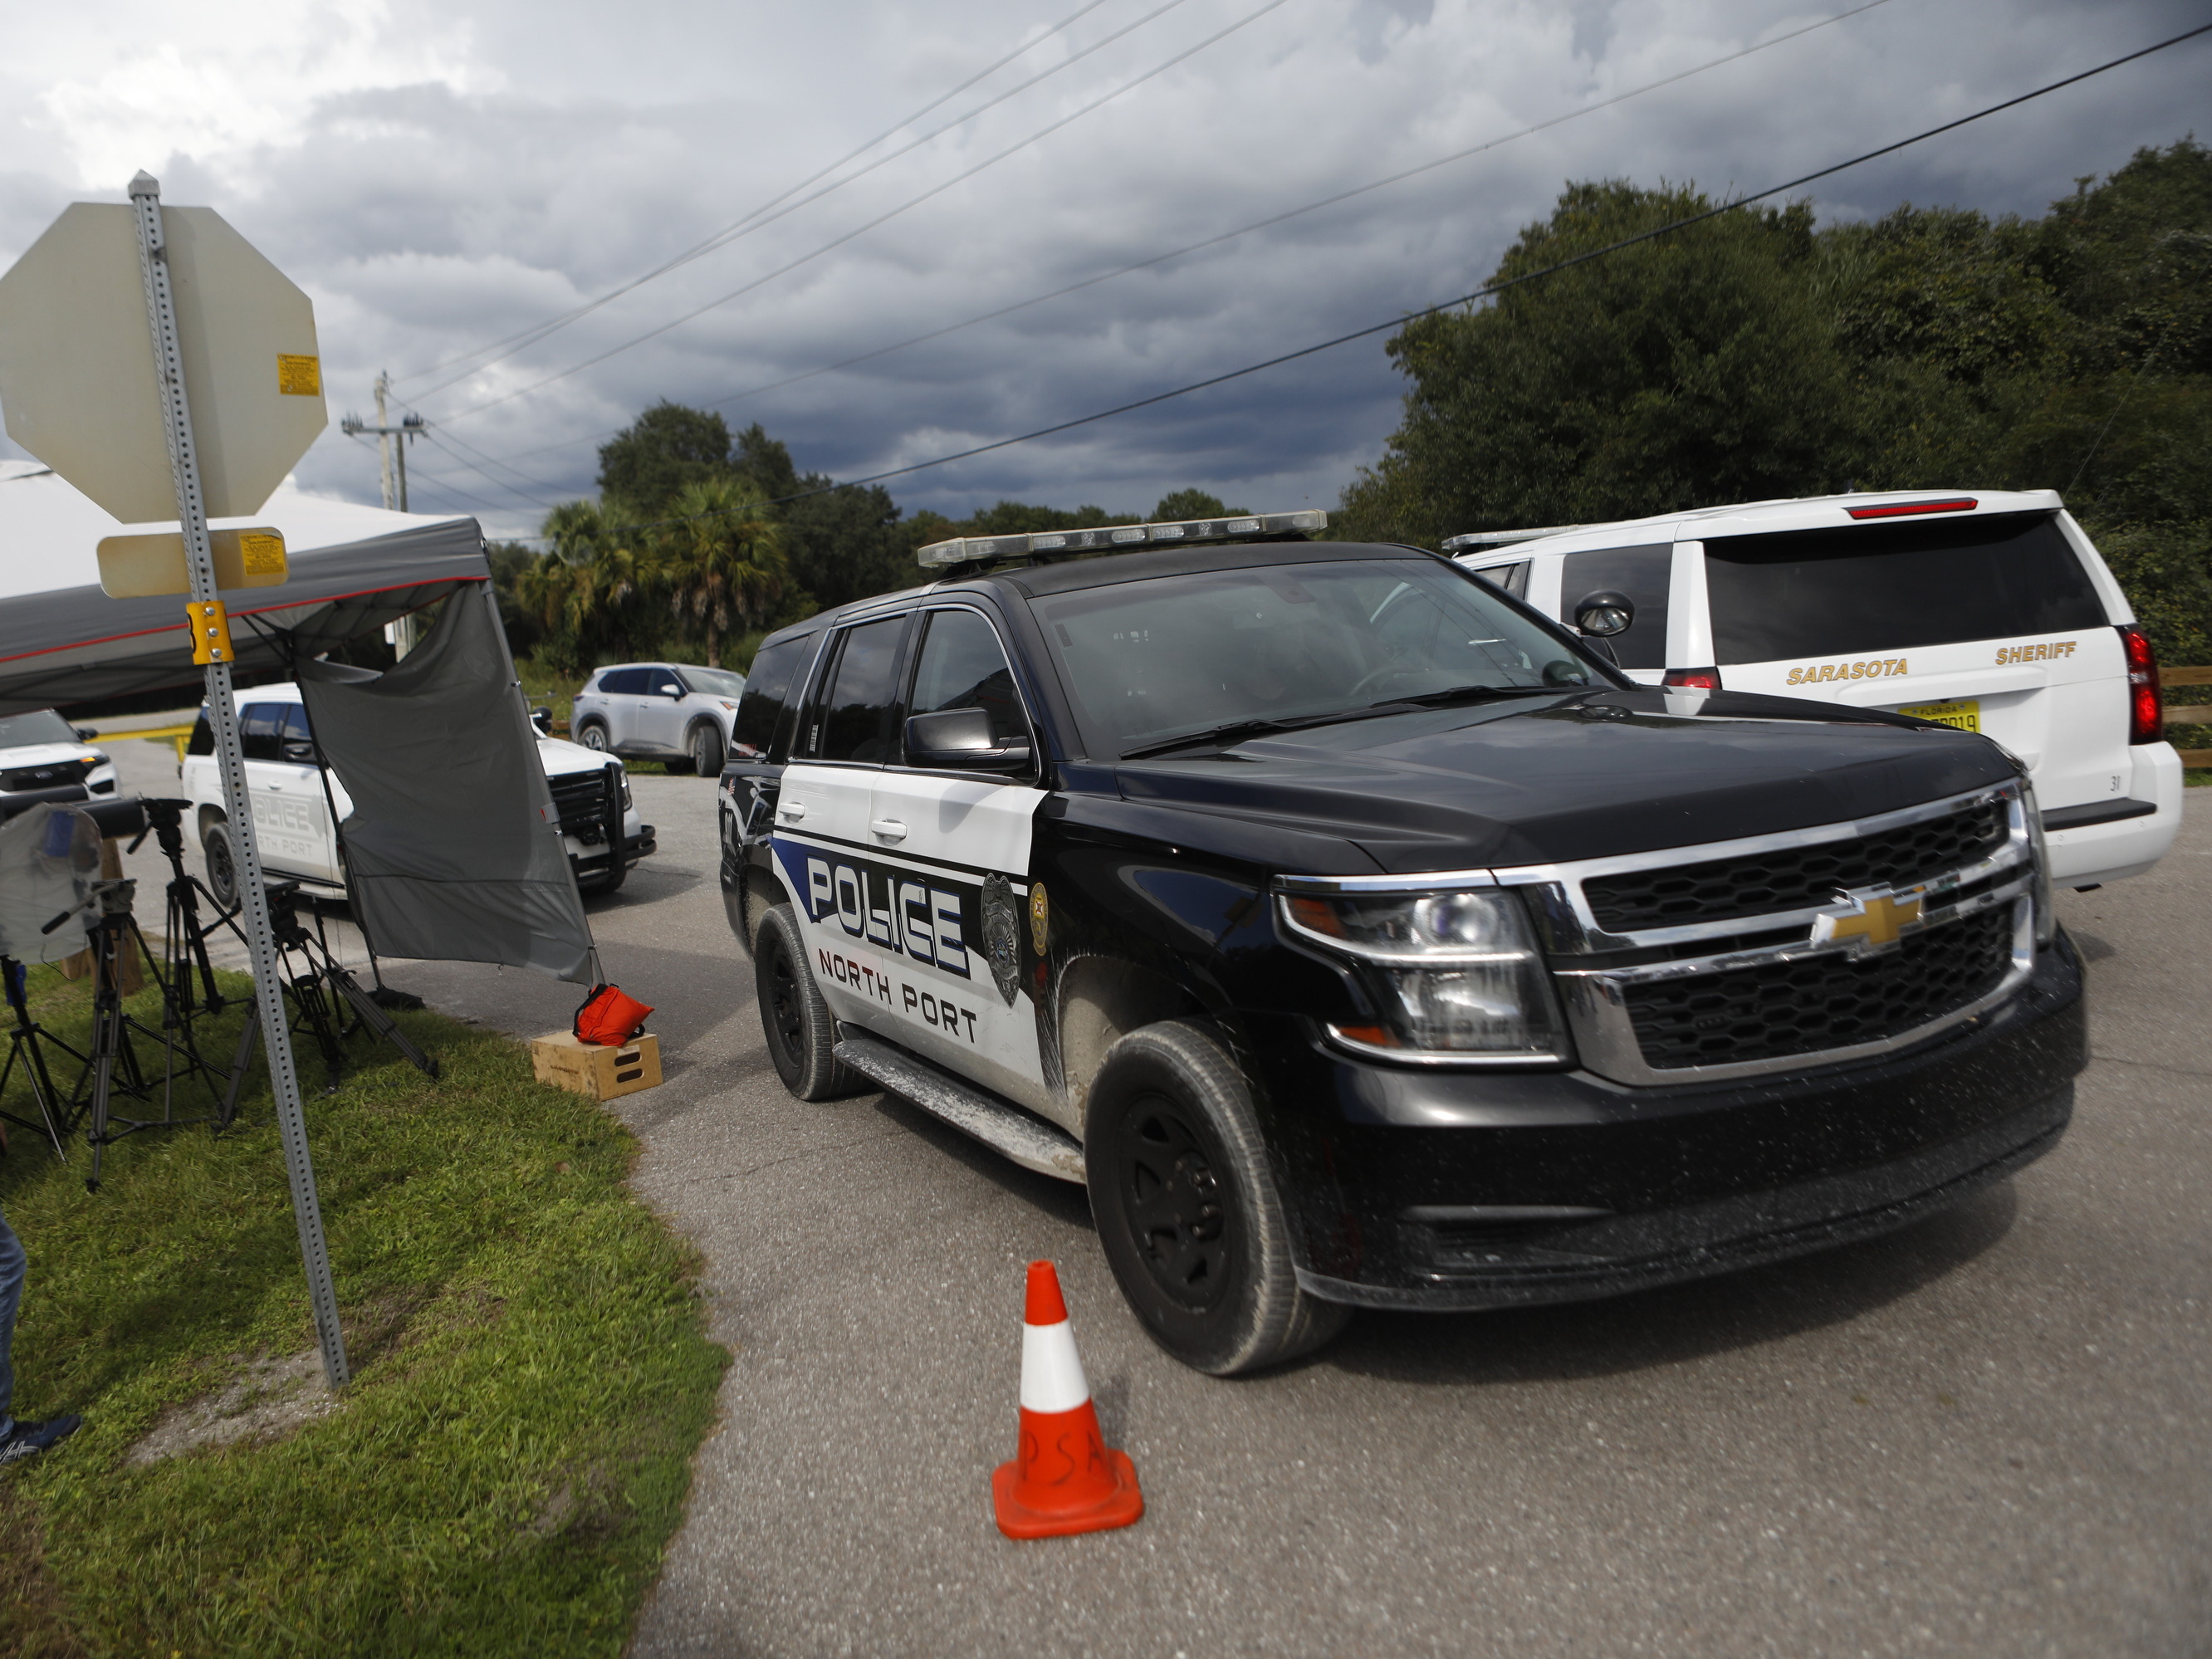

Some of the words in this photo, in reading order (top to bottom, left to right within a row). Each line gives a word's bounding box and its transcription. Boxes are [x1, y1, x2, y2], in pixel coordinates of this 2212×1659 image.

[1995, 641, 2077, 665] SHERIFF
[1786, 658, 1907, 685] SARASOTA
[1921, 706, 1958, 716] FLORIDA
[2110, 775, 2121, 791] 31
[252, 797, 310, 831] OLICE
[257, 834, 279, 850] RTH
[283, 839, 313, 857] PORT
[806, 855, 970, 978] POLICE
[818, 947, 893, 1006] NORTH
[901, 982, 977, 1044] PORT
[1022, 1429, 1106, 1485] PSA
